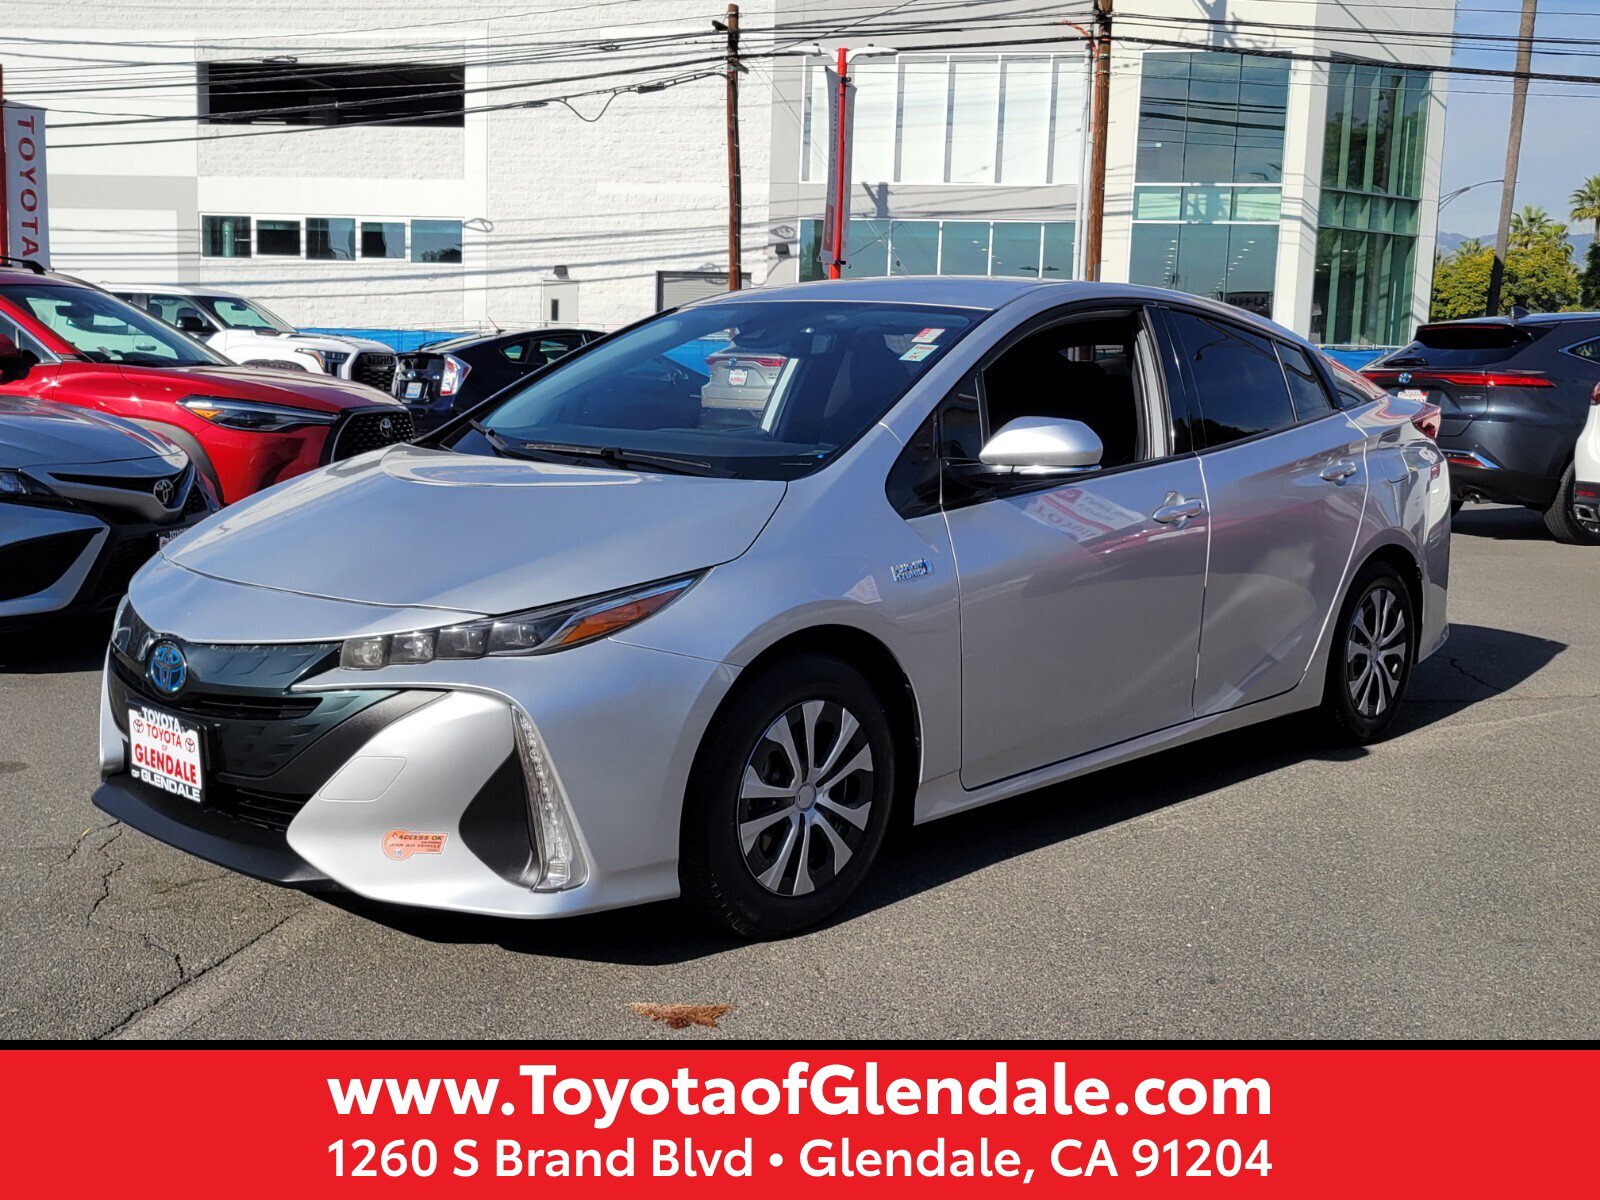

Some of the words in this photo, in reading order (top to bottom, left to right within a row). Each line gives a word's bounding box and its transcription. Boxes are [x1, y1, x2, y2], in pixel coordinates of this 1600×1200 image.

[17, 116, 39, 257] TOYOTA
[895, 568, 926, 580] HYBRID
[141, 706, 182, 733] TOYOTA
[146, 723, 183, 749] TOYOTA
[134, 743, 197, 785] GLENDALE
[131, 769, 140, 778] OF
[141, 768, 201, 803] GLENDALE
